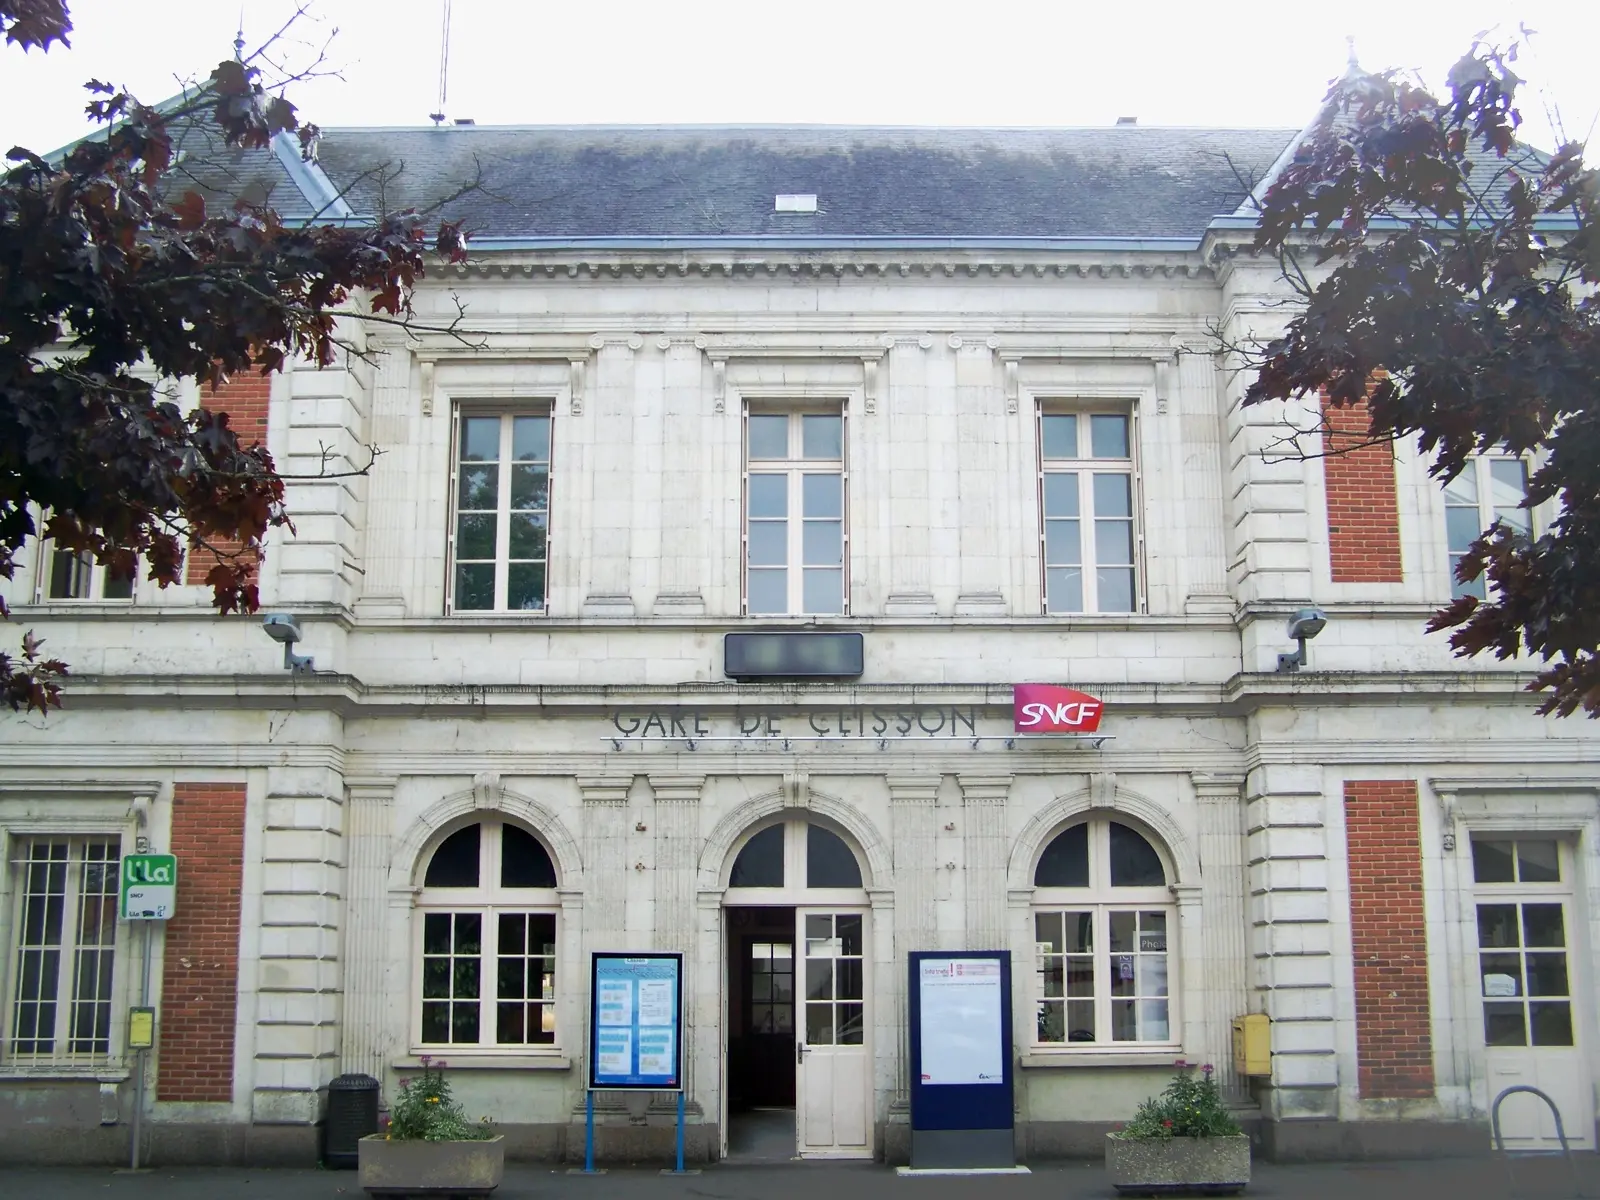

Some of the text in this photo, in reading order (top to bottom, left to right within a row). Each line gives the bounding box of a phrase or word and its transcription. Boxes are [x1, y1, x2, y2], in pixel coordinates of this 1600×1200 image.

[613, 707, 977, 735] GARE DE CLISSON
[1018, 702, 1100, 727] SNCF
